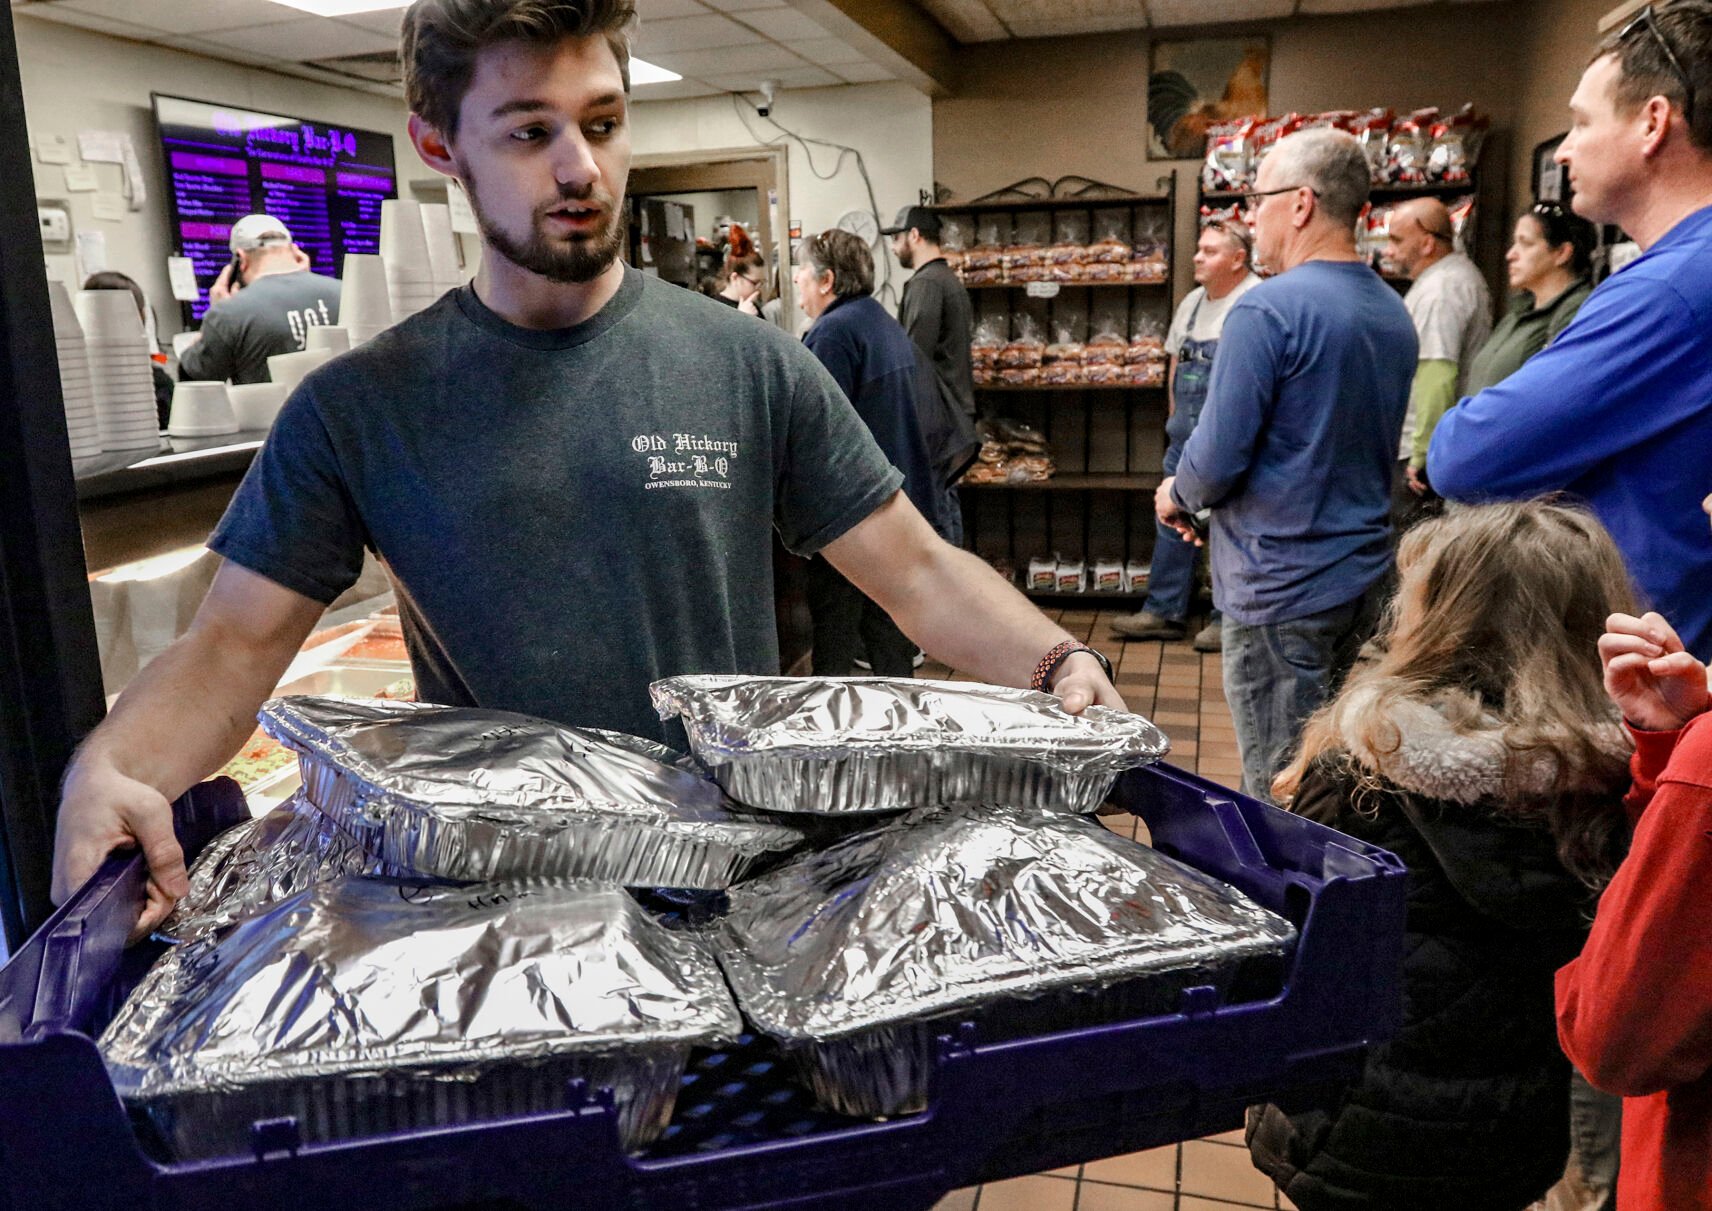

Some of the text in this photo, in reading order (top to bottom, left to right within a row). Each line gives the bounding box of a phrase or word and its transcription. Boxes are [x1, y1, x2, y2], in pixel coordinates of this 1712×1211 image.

[632, 434, 737, 458] Old Hickory
[648, 455, 728, 479] Bar-B-Q
[645, 480, 731, 490] OWENSBORO, KENTUCKY
